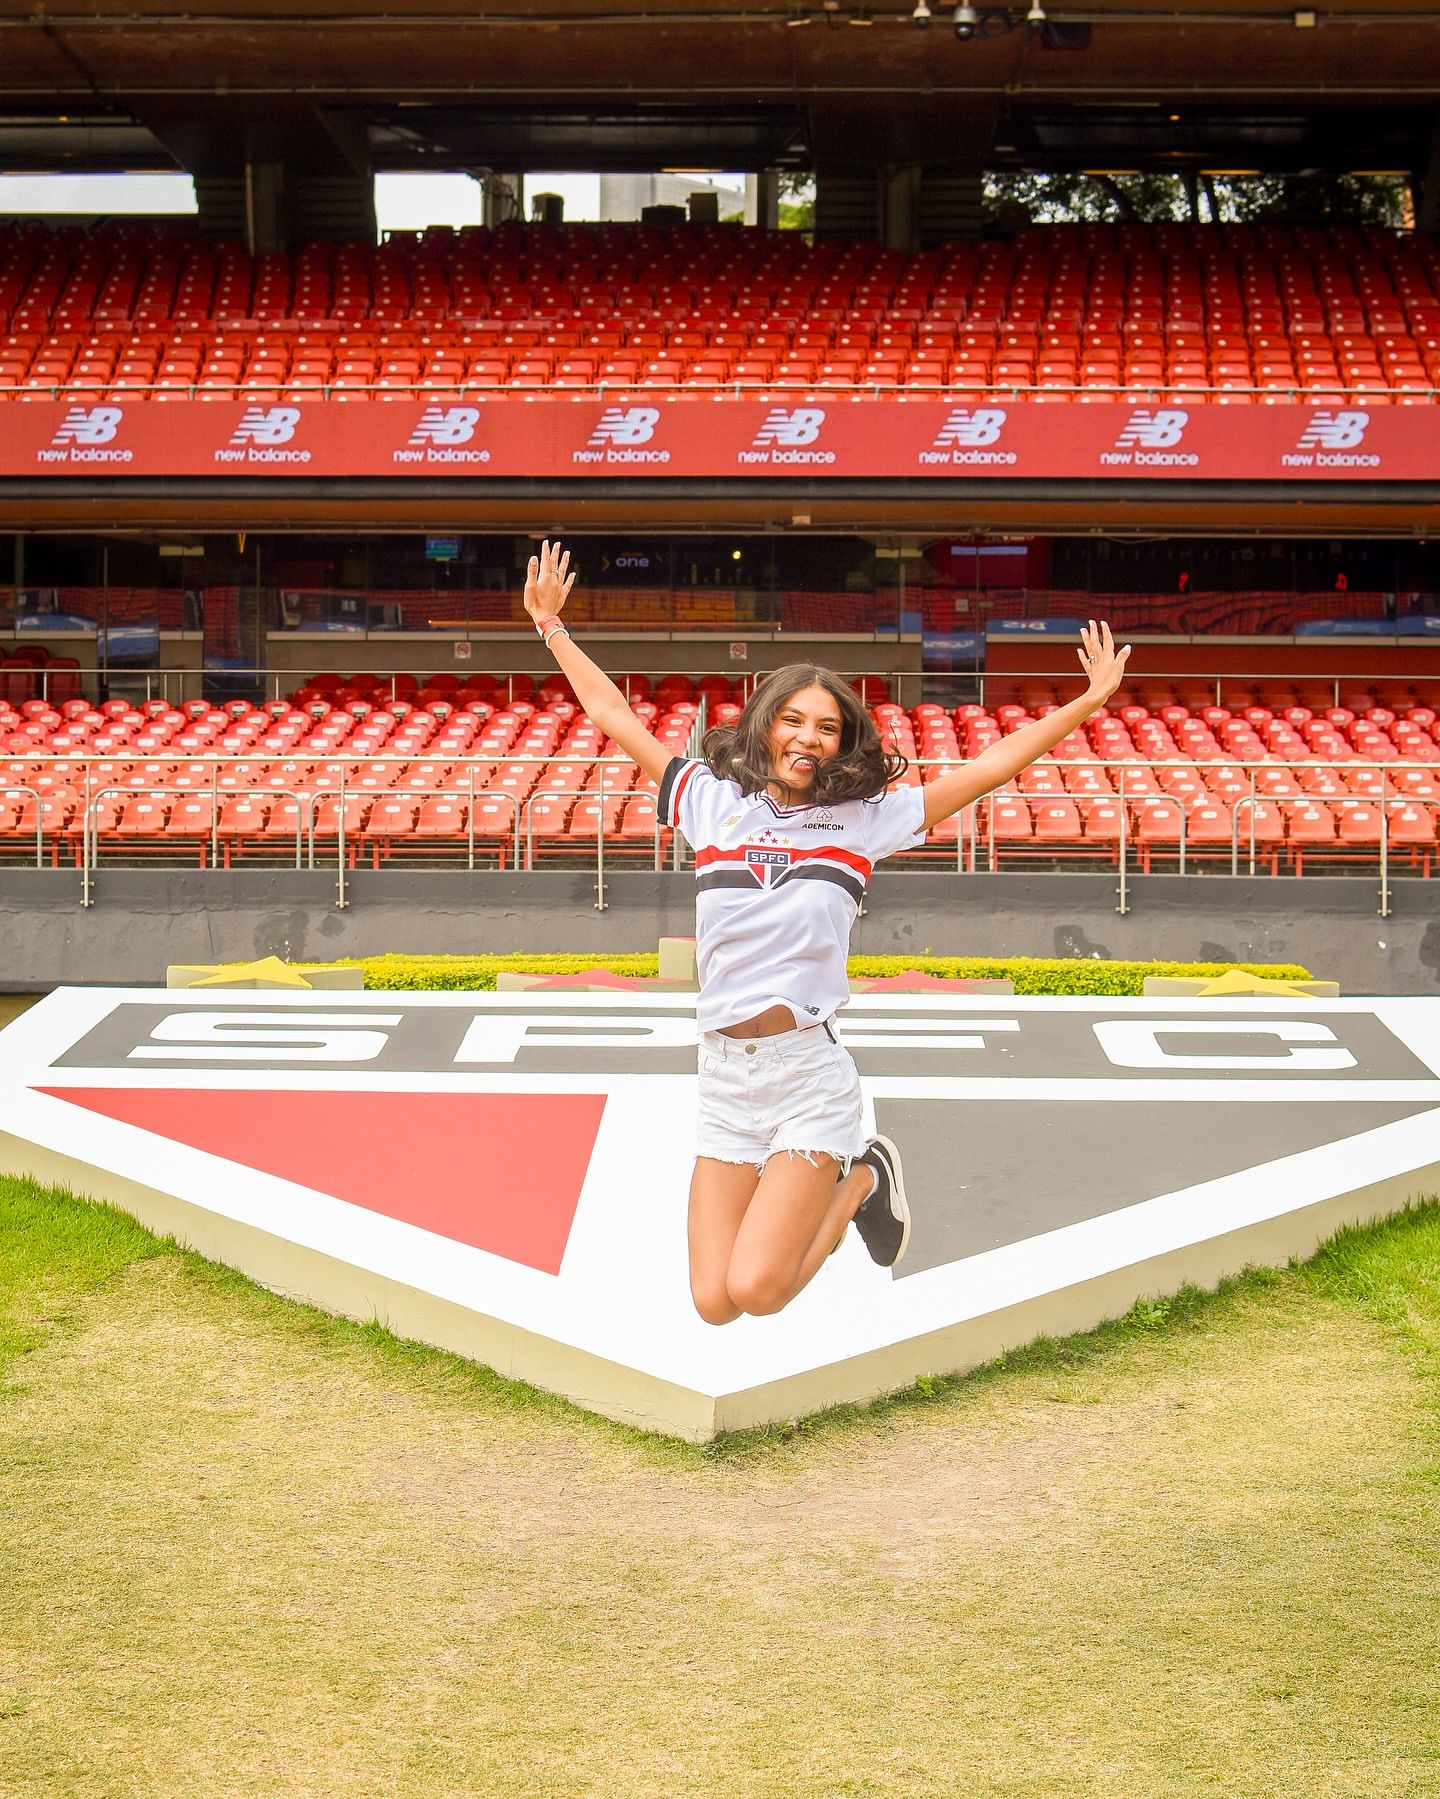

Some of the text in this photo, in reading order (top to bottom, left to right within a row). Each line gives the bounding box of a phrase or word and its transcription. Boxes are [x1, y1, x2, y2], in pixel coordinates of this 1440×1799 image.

[51, 407, 123, 444] NB
[229, 407, 301, 444] NB
[408, 408, 480, 445] NB
[587, 408, 660, 445] NB
[752, 409, 825, 445] NB
[933, 409, 1006, 446] NB
[1115, 410, 1188, 447] NB
[1297, 411, 1369, 447] NB
[38, 448, 133, 461] new balance
[215, 448, 311, 462] new balance
[393, 448, 490, 462] new balance
[573, 449, 670, 462] new balance
[738, 449, 835, 463] new balance
[919, 450, 1017, 464] new balance
[1101, 451, 1198, 465] new balance
[1282, 453, 1380, 466] new balance
[615, 557, 650, 567] one
[801, 822, 844, 831] ADEMICON
[751, 853, 785, 864] SPFC
